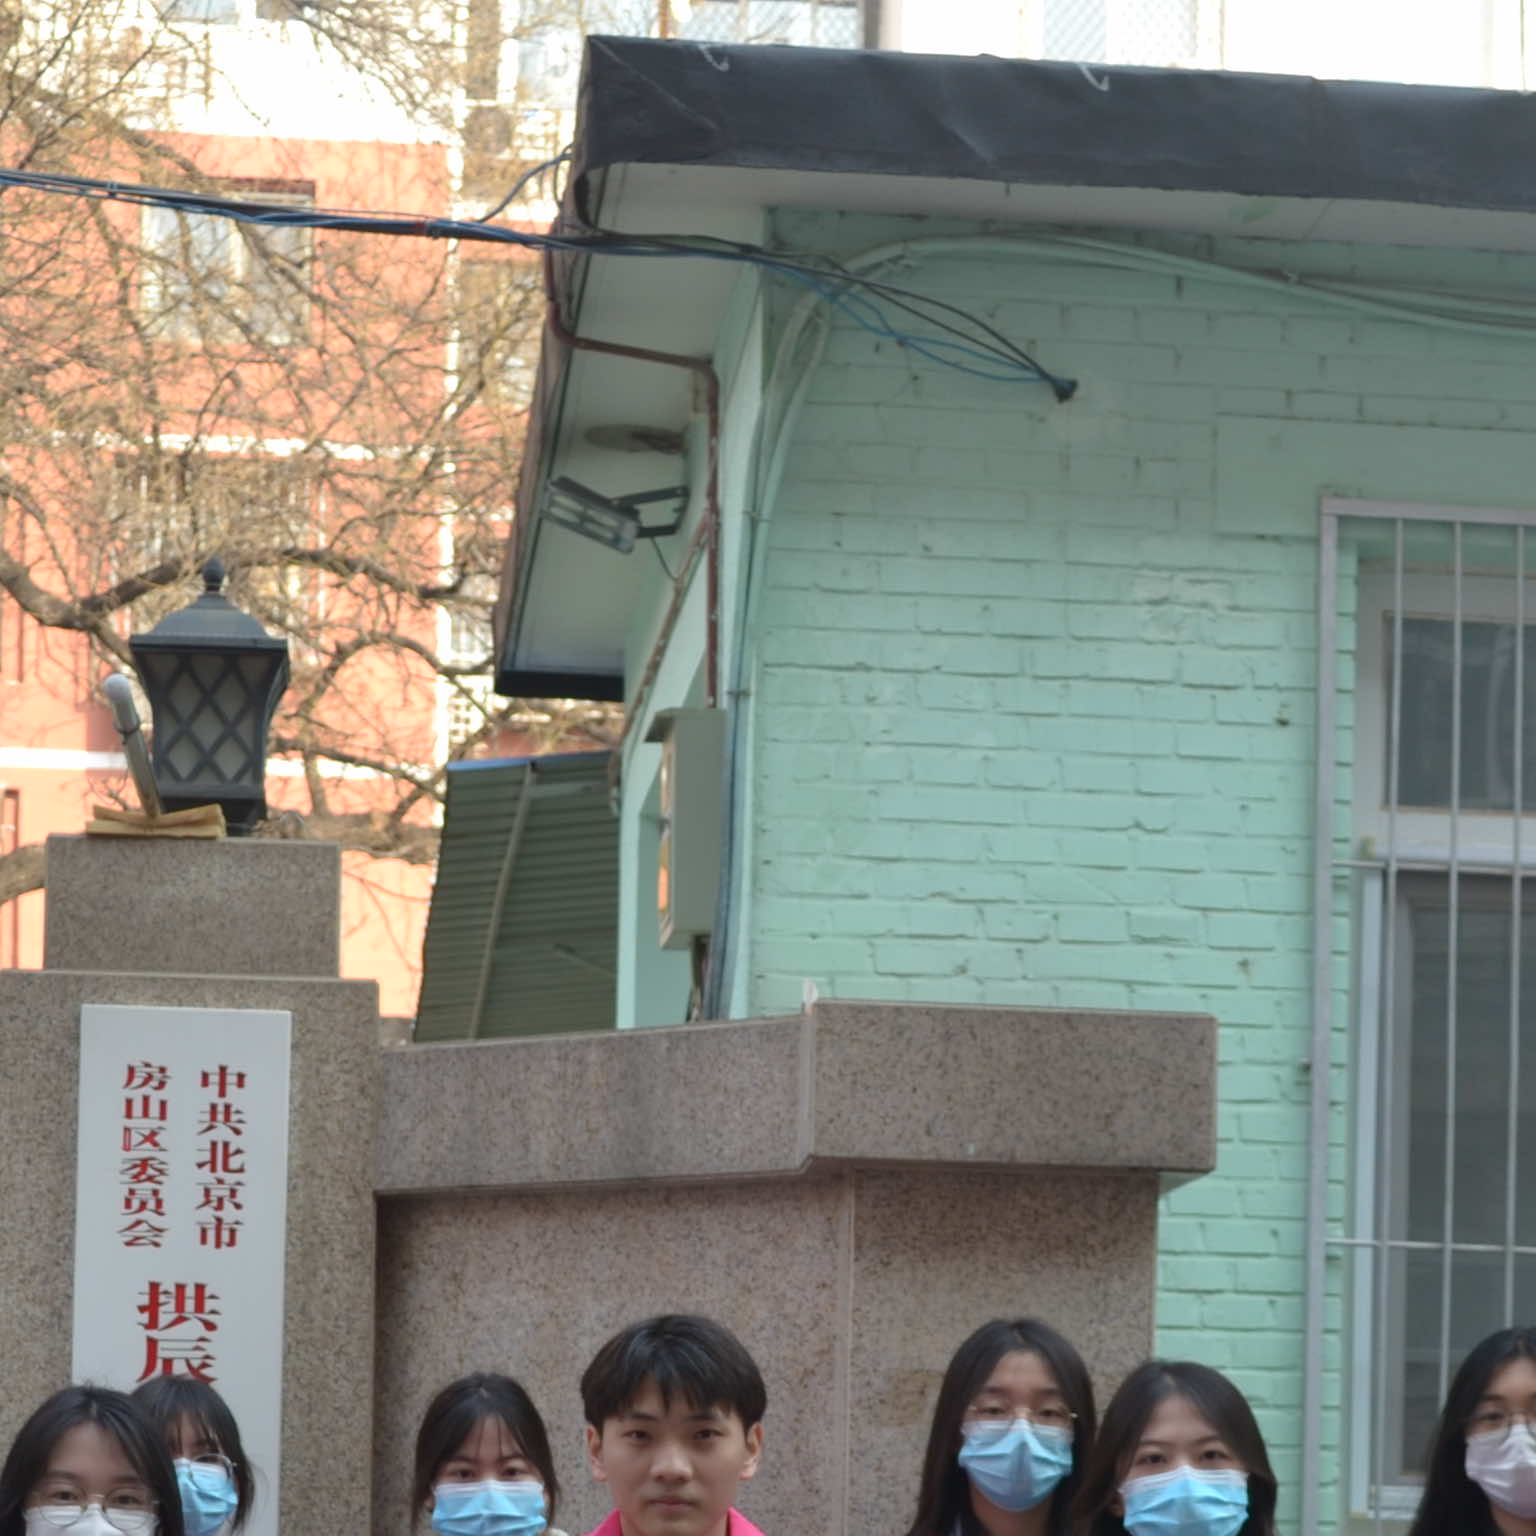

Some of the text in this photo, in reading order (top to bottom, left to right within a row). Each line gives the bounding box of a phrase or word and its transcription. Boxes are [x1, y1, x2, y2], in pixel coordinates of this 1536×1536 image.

[117, 1061, 171, 1248] 房山区委员会
[196, 1064, 248, 1249] 中共北京市
